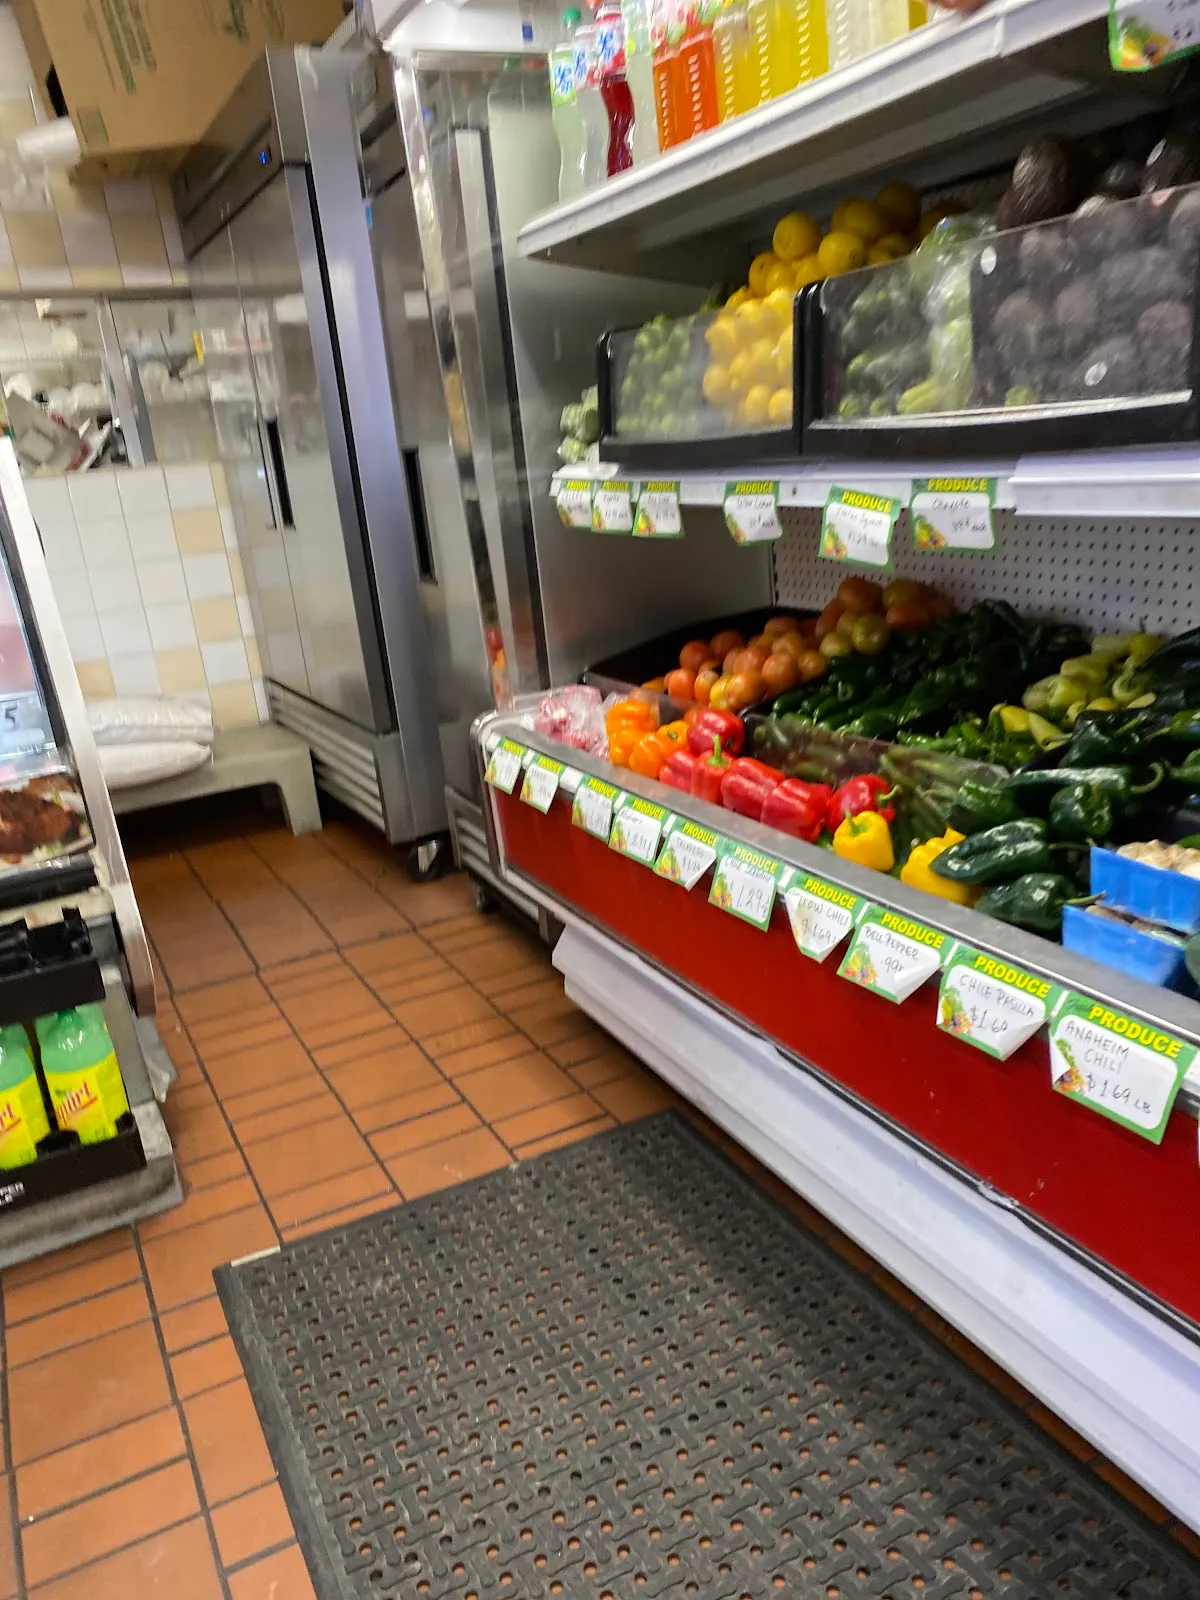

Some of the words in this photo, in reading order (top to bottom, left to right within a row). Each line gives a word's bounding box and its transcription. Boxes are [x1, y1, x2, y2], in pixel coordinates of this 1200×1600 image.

[647, 481, 677, 493] PRODUCE
[735, 481, 774, 495] PRODUCE
[928, 478, 988, 492] PRODUCE
[841, 489, 894, 513] PRODUCE
[632, 799, 665, 820] PRODUCE
[682, 821, 718, 847] PRODUCE
[735, 846, 778, 874] PRODUCE
[804, 878, 857, 909] PRODUCE
[881, 912, 945, 949] PRODUCE
[886, 932, 919, 960] PEPPER
[960, 974, 991, 999] CHILE
[973, 955, 1052, 998] PRODUCE
[1064, 1019, 1129, 1060] ANAHEIM
[1088, 1004, 1184, 1058] PRODUCE
[1084, 1048, 1123, 1075] CHILI
[1136, 1098, 1151, 1114] LB
